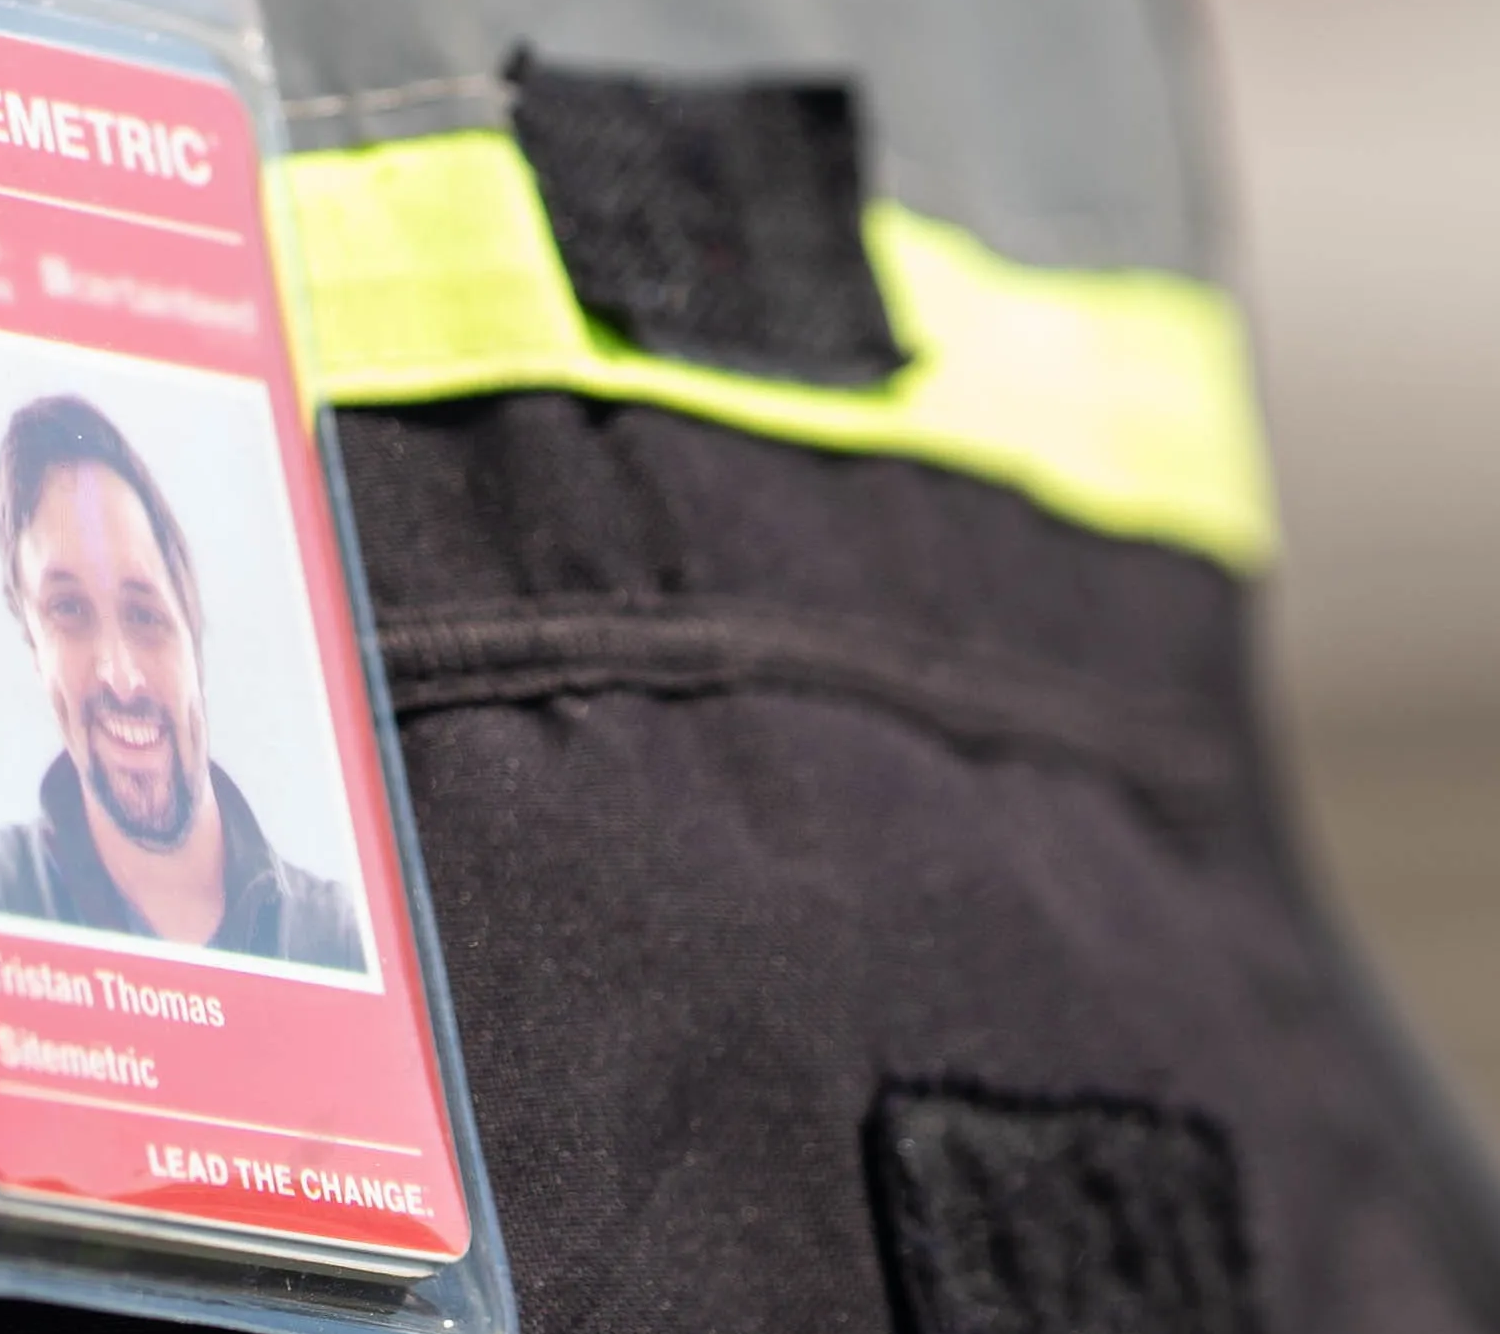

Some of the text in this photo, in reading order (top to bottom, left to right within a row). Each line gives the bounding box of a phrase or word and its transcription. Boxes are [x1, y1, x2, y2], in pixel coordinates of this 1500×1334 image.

[94, 969, 226, 1028] Thomas
[145, 1143, 435, 1218] LEAD THE CHANGE.
